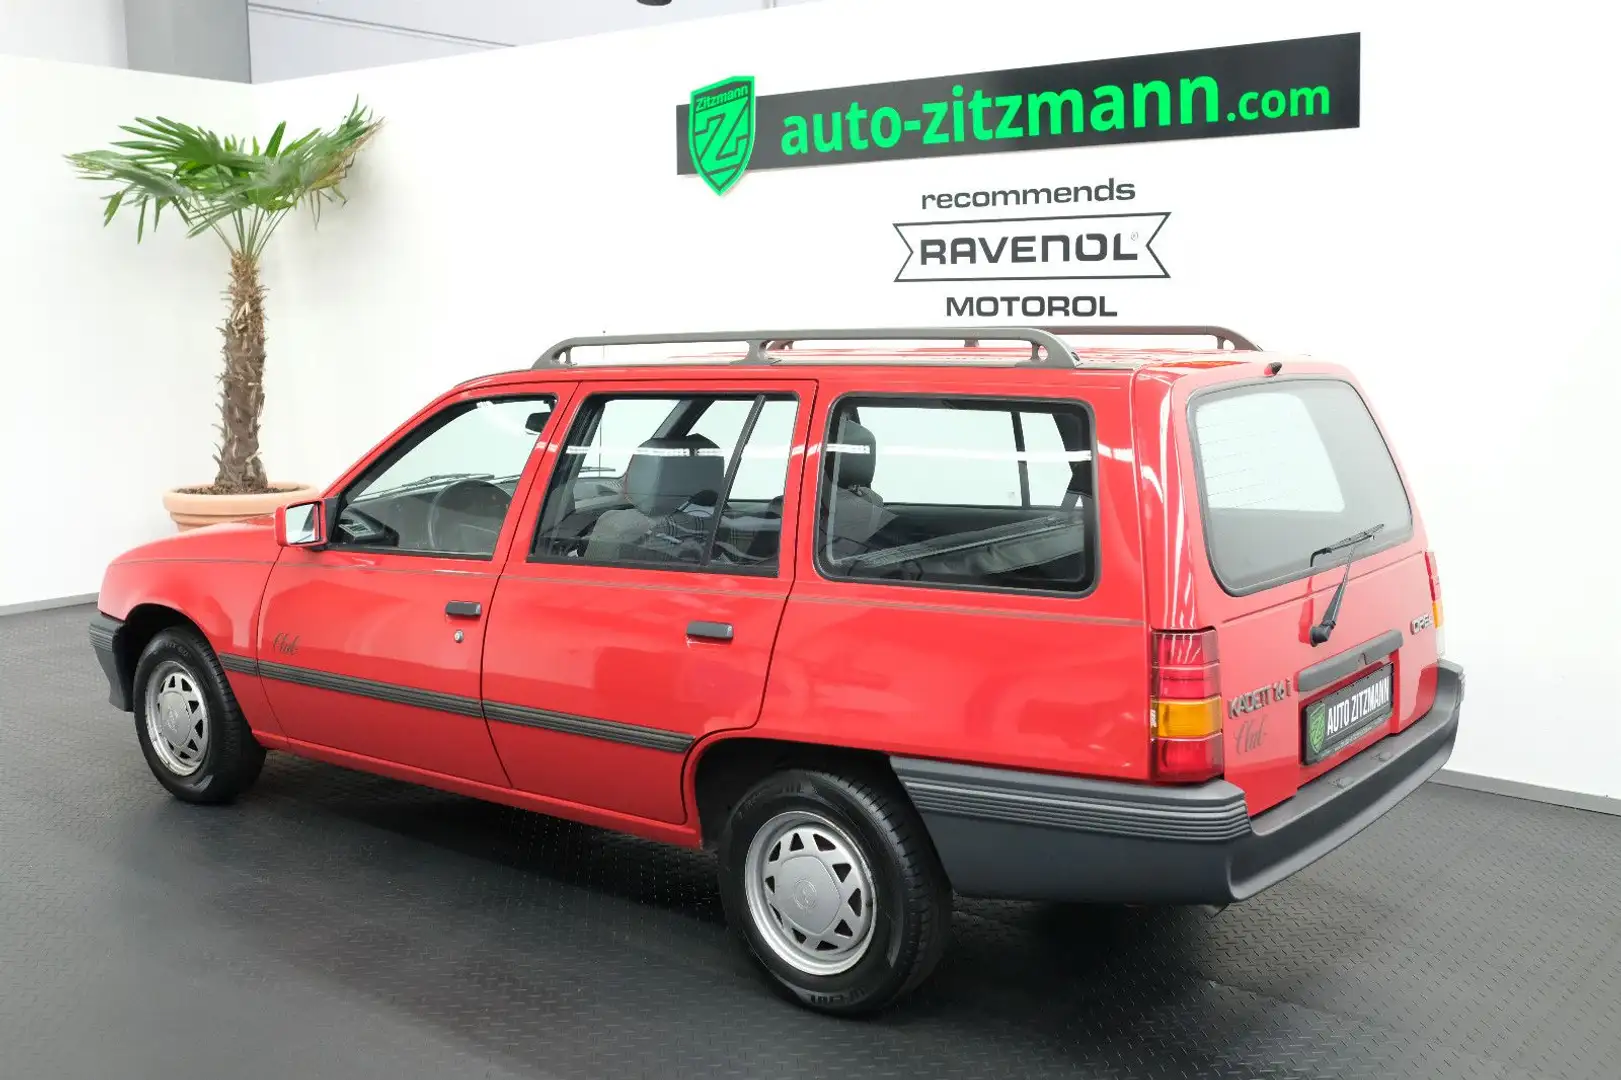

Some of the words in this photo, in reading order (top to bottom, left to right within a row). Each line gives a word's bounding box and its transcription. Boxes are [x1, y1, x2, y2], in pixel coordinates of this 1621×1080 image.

[696, 85, 749, 110] Zitzmann
[781, 74, 1330, 156] auto-zitzmann.com
[921, 177, 1136, 210] recommends
[919, 232, 1138, 265] RAVENOL
[946, 295, 1118, 318] MOTOROL
[1228, 684, 1272, 719] KADETT
[1327, 699, 1350, 736] AUTO
[1351, 676, 1390, 723] ZITZMANN
